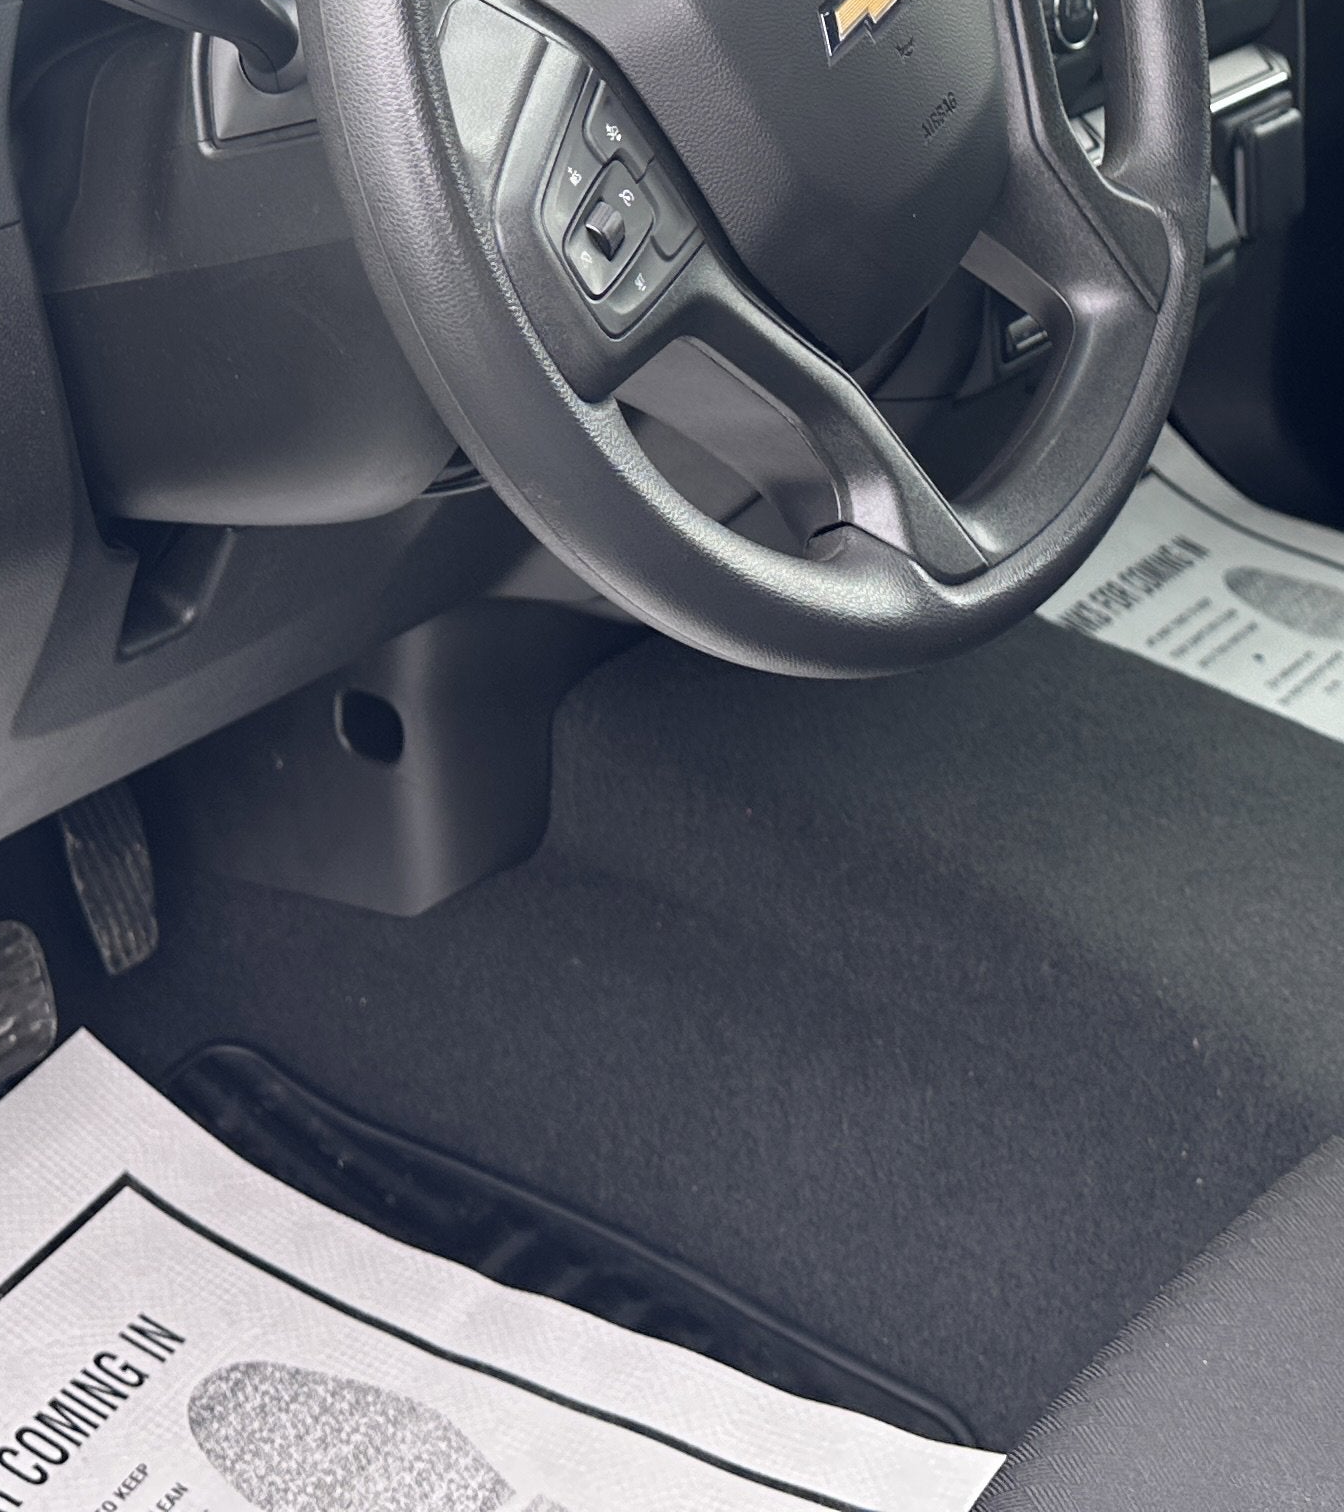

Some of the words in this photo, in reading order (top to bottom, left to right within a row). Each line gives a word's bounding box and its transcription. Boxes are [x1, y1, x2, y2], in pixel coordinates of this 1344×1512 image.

[118, 1312, 187, 1364] IN
[112, 1462, 149, 1501] KEEP
[156, 1481, 189, 1512] EAN
